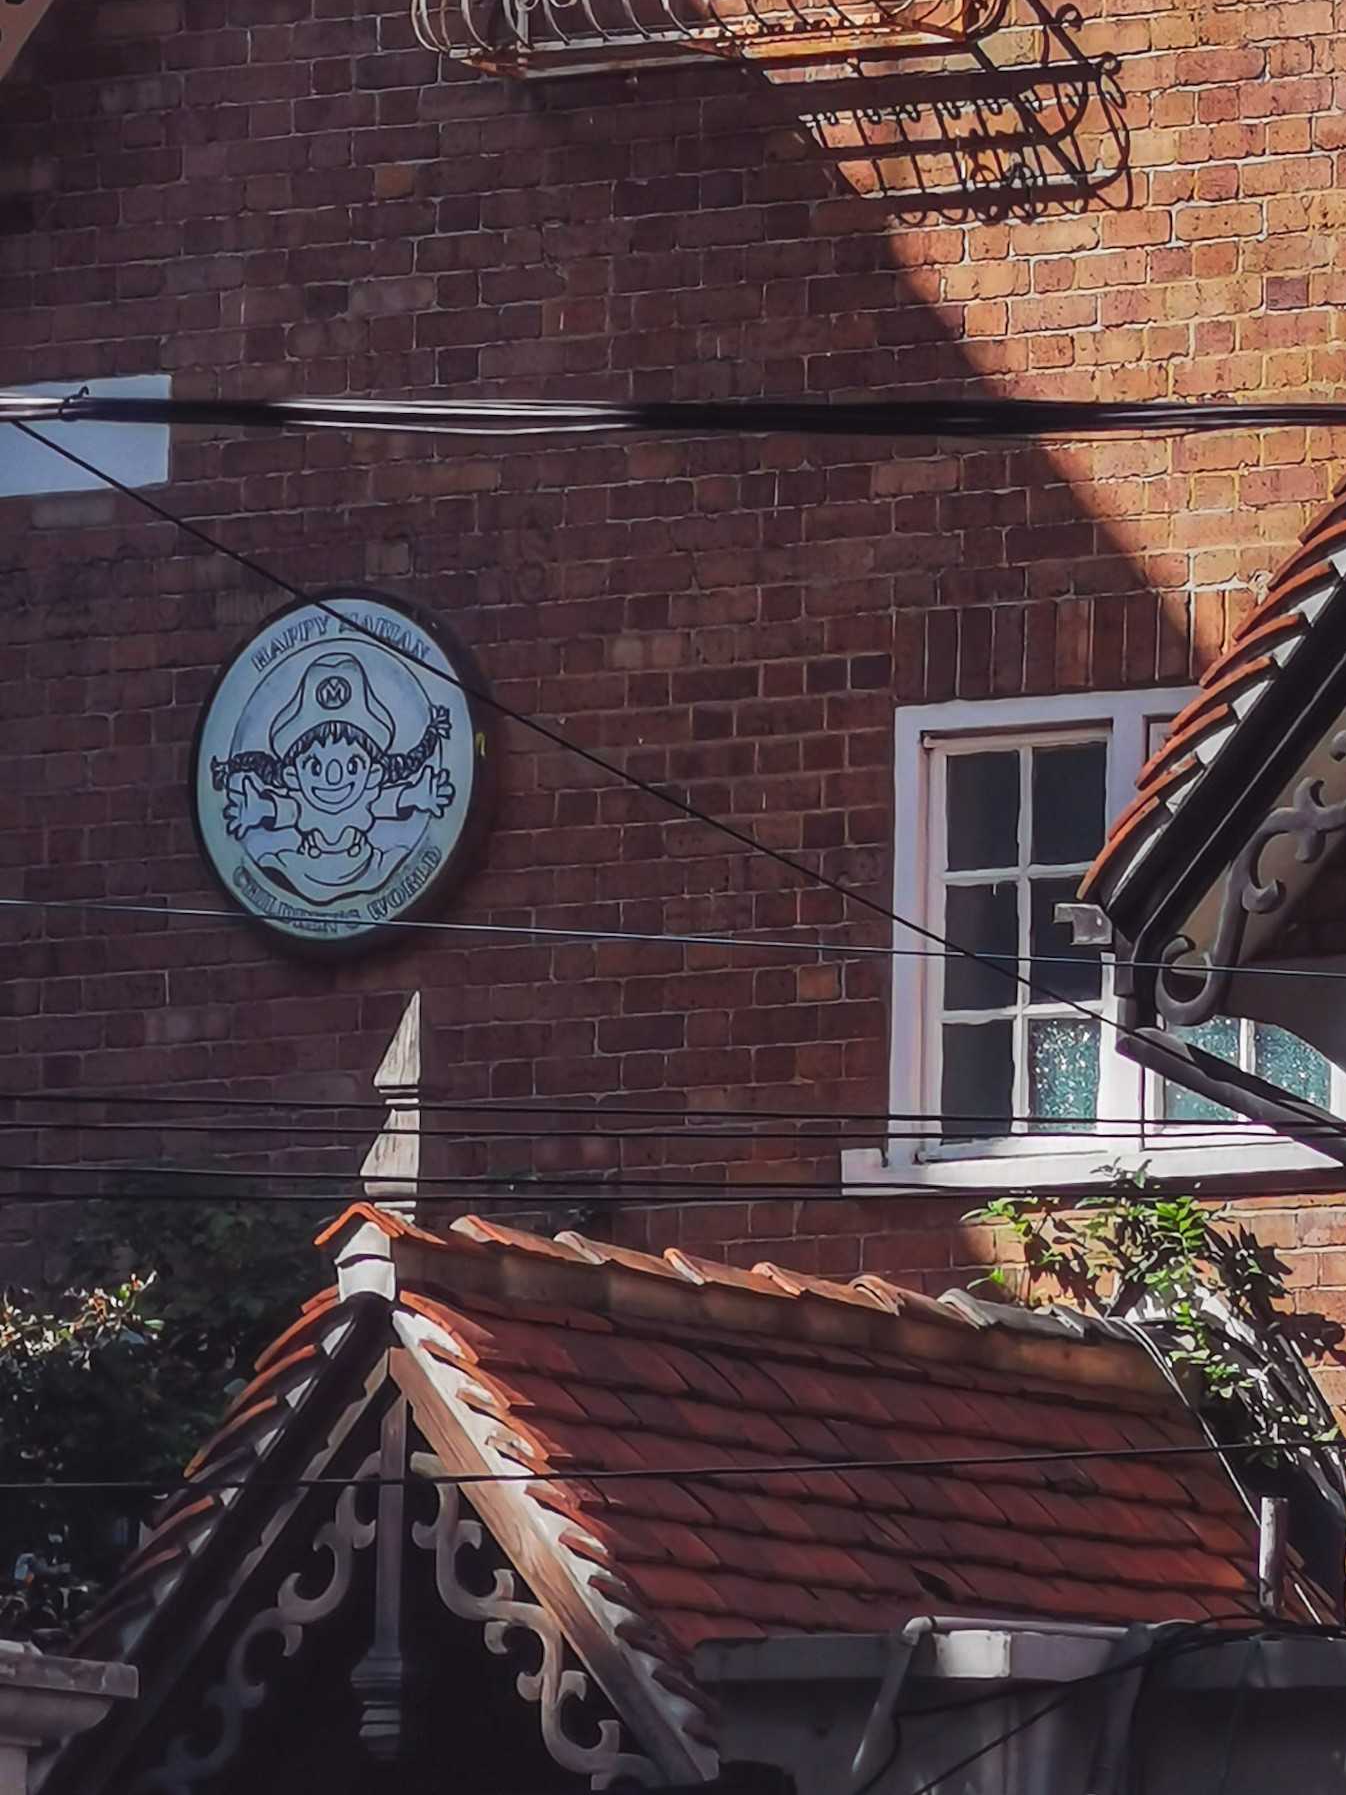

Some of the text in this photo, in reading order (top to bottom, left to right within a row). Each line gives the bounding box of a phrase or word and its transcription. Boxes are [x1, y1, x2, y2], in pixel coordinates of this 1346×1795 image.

[251, 615, 329, 672] HAPPY
[319, 679, 347, 705] M
[367, 848, 442, 920] WORLD
